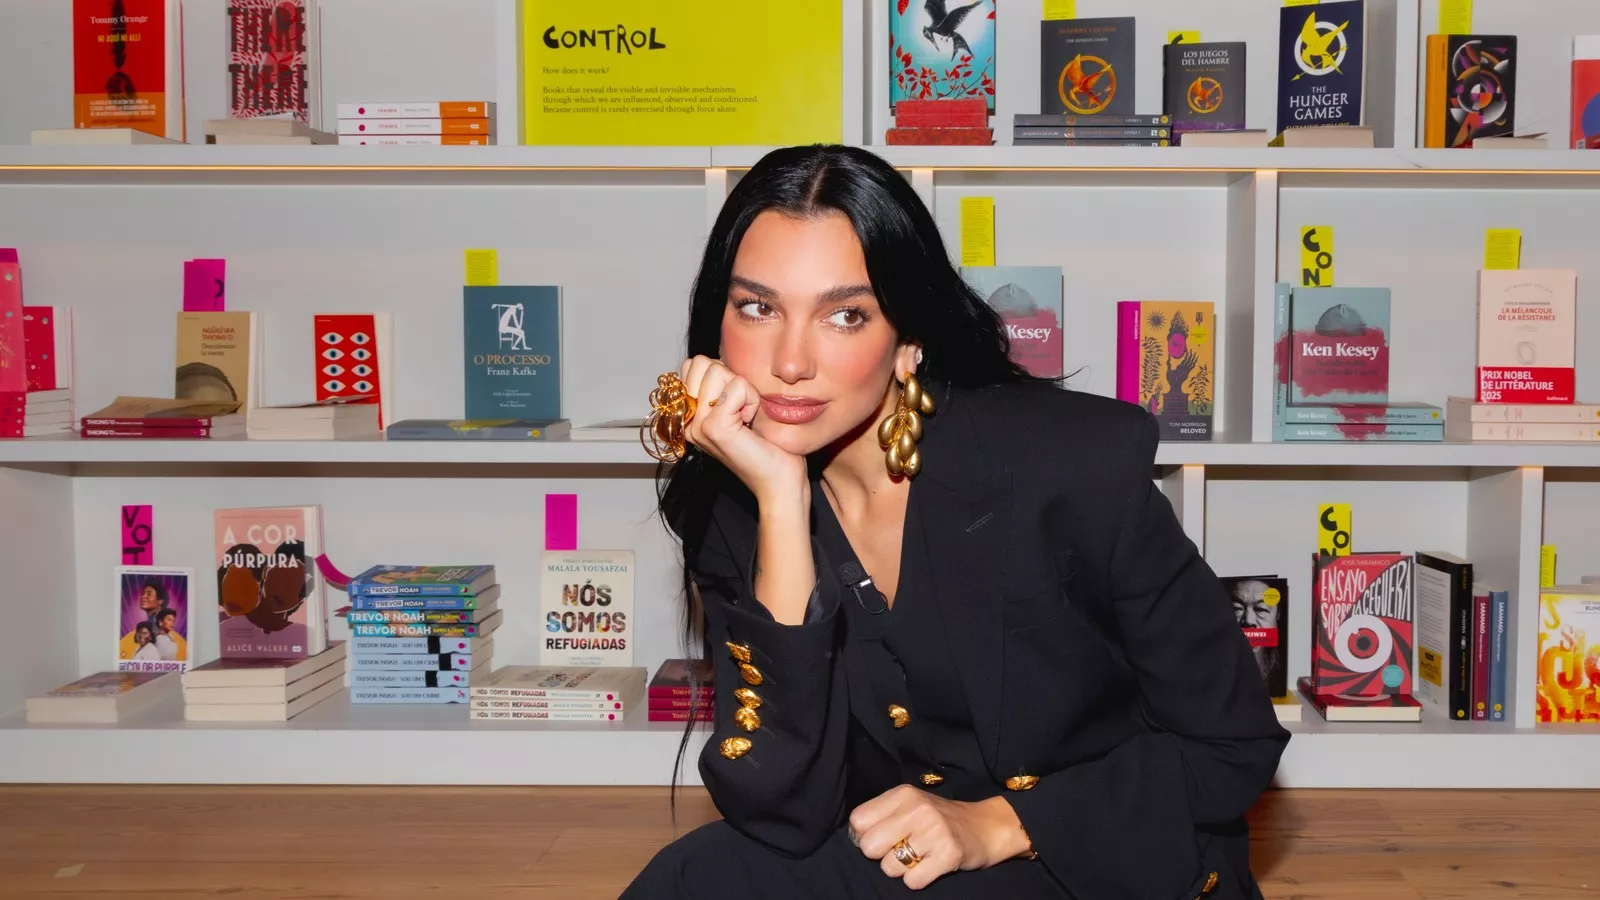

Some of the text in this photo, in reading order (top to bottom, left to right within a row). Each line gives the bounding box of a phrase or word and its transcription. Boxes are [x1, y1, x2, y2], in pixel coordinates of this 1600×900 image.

[90, 15, 148, 24] Tommy Orange
[543, 24, 666, 55] CONTROL
[1199, 50, 1228, 58] JUEGOS
[543, 67, 560, 75] How
[561, 66, 578, 74] does
[587, 66, 609, 74] work?
[543, 86, 565, 94] Books
[566, 86, 581, 94] that
[582, 86, 605, 94] reveal
[619, 86, 643, 94] visible
[691, 85, 736, 93] mechanisms
[1311, 85, 1327, 93] THE
[543, 95, 571, 105] through
[573, 96, 596, 104] which
[623, 95, 664, 105] influenced,
[664, 95, 698, 104] observed
[698, 95, 712, 103] and
[713, 95, 759, 104] conditioned.
[1290, 93, 1349, 108] HUNGER
[543, 105, 571, 113] Because
[572, 105, 600, 113] control
[608, 105, 630, 114] rarely
[631, 105, 664, 113] exercised
[665, 104, 695, 114] through
[696, 104, 716, 113] force
[1294, 106, 1342, 120] GAMES
[1006, 325, 1052, 342] Kesey
[1302, 342, 1380, 360] Ken Kesey
[474, 354, 550, 365] O PROCESSO
[487, 367, 537, 376] Franz Kafka
[1481, 370, 1533, 380] PRIX NOBEL
[1481, 379, 1554, 390] DE LITTÉRATURE
[1481, 391, 1502, 400] 2025
[1309, 412, 1328, 420] Kesey
[223, 524, 299, 545] A COR
[223, 549, 299, 569] PÚRPURA
[1321, 566, 1367, 603] ENSAYO
[1362, 558, 1411, 621] CEGUERA
[562, 579, 612, 606] NÓS
[350, 612, 390, 622] TREVOR
[392, 611, 424, 621] NOAH
[546, 611, 626, 633] SOMOS
[356, 626, 396, 635] TREVOR
[399, 626, 431, 635] NOAH
[227, 644, 288, 652] ALICE WALKER
[546, 638, 626, 650] REFUGIADAS
